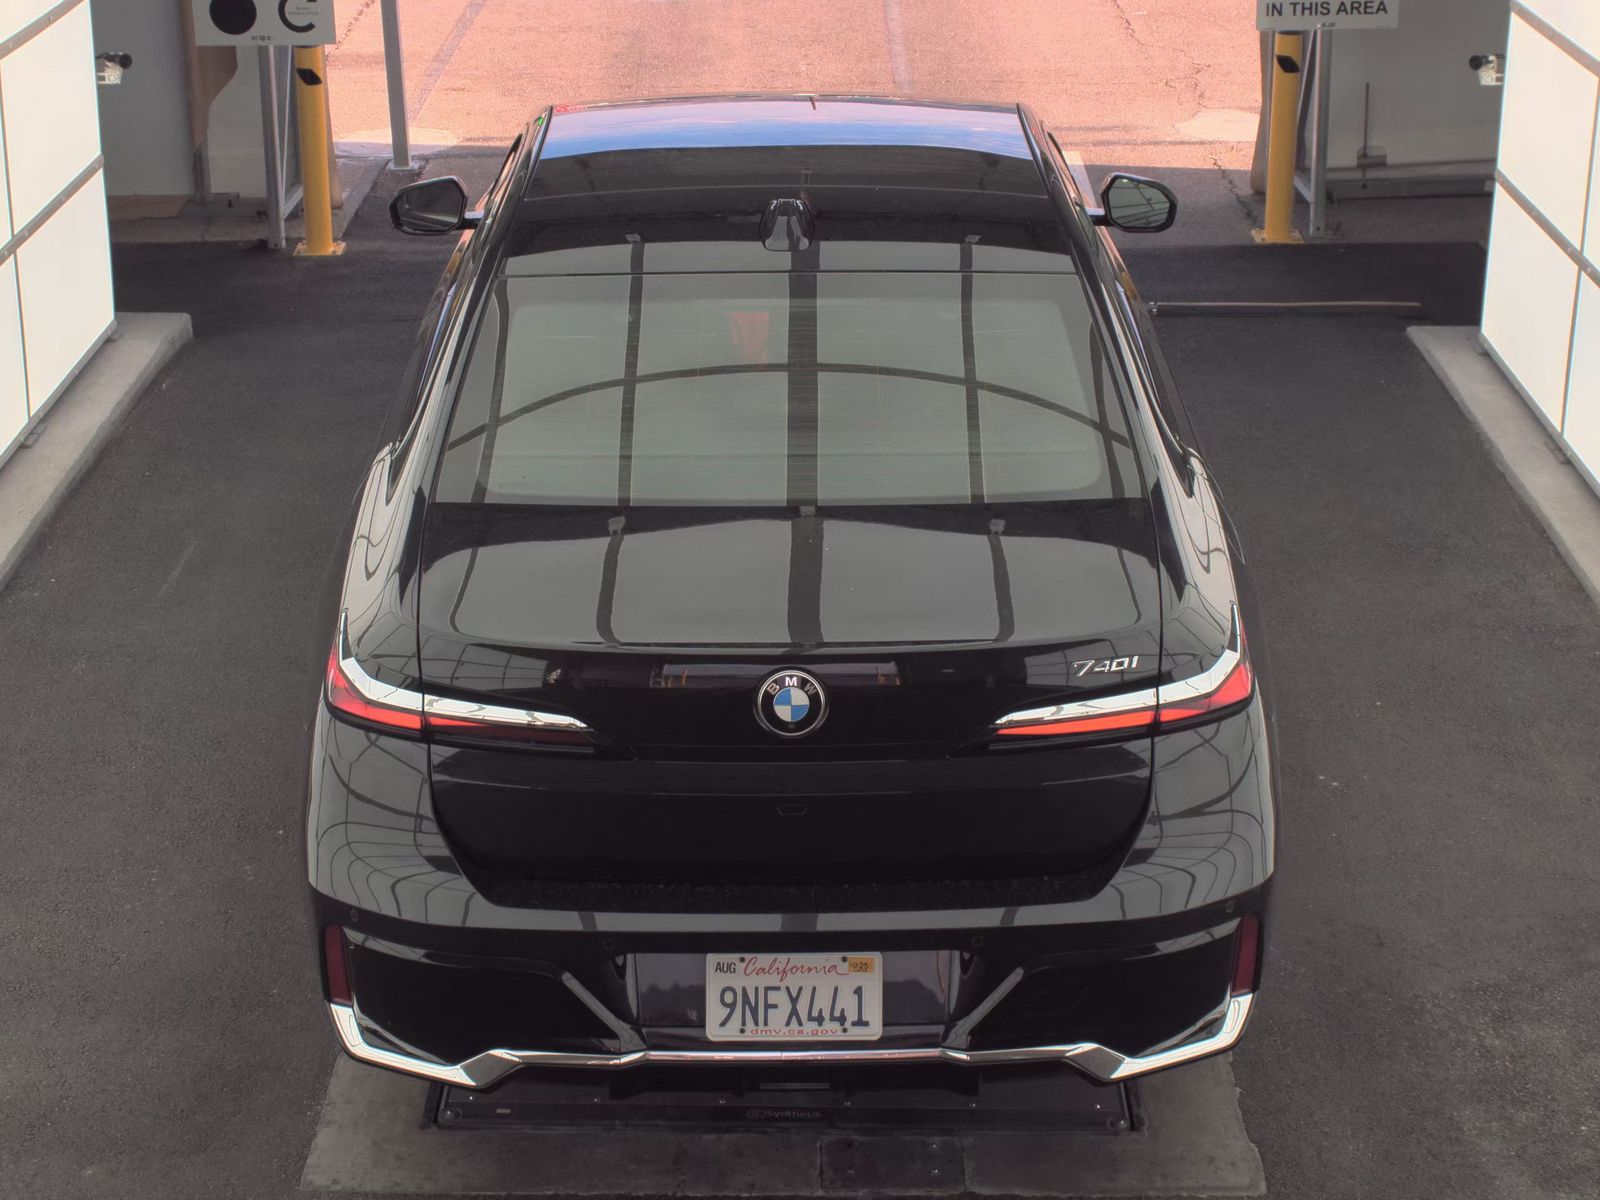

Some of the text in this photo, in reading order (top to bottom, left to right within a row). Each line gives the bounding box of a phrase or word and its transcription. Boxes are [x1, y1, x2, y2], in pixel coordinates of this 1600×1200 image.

[1266, 1, 1388, 17] IN THIS AREA
[766, 676, 818, 696] BMW
[715, 956, 849, 983] AUG California
[719, 985, 870, 1027] 9NFX441
[750, 1028, 838, 1036] dmv.ca.gov
